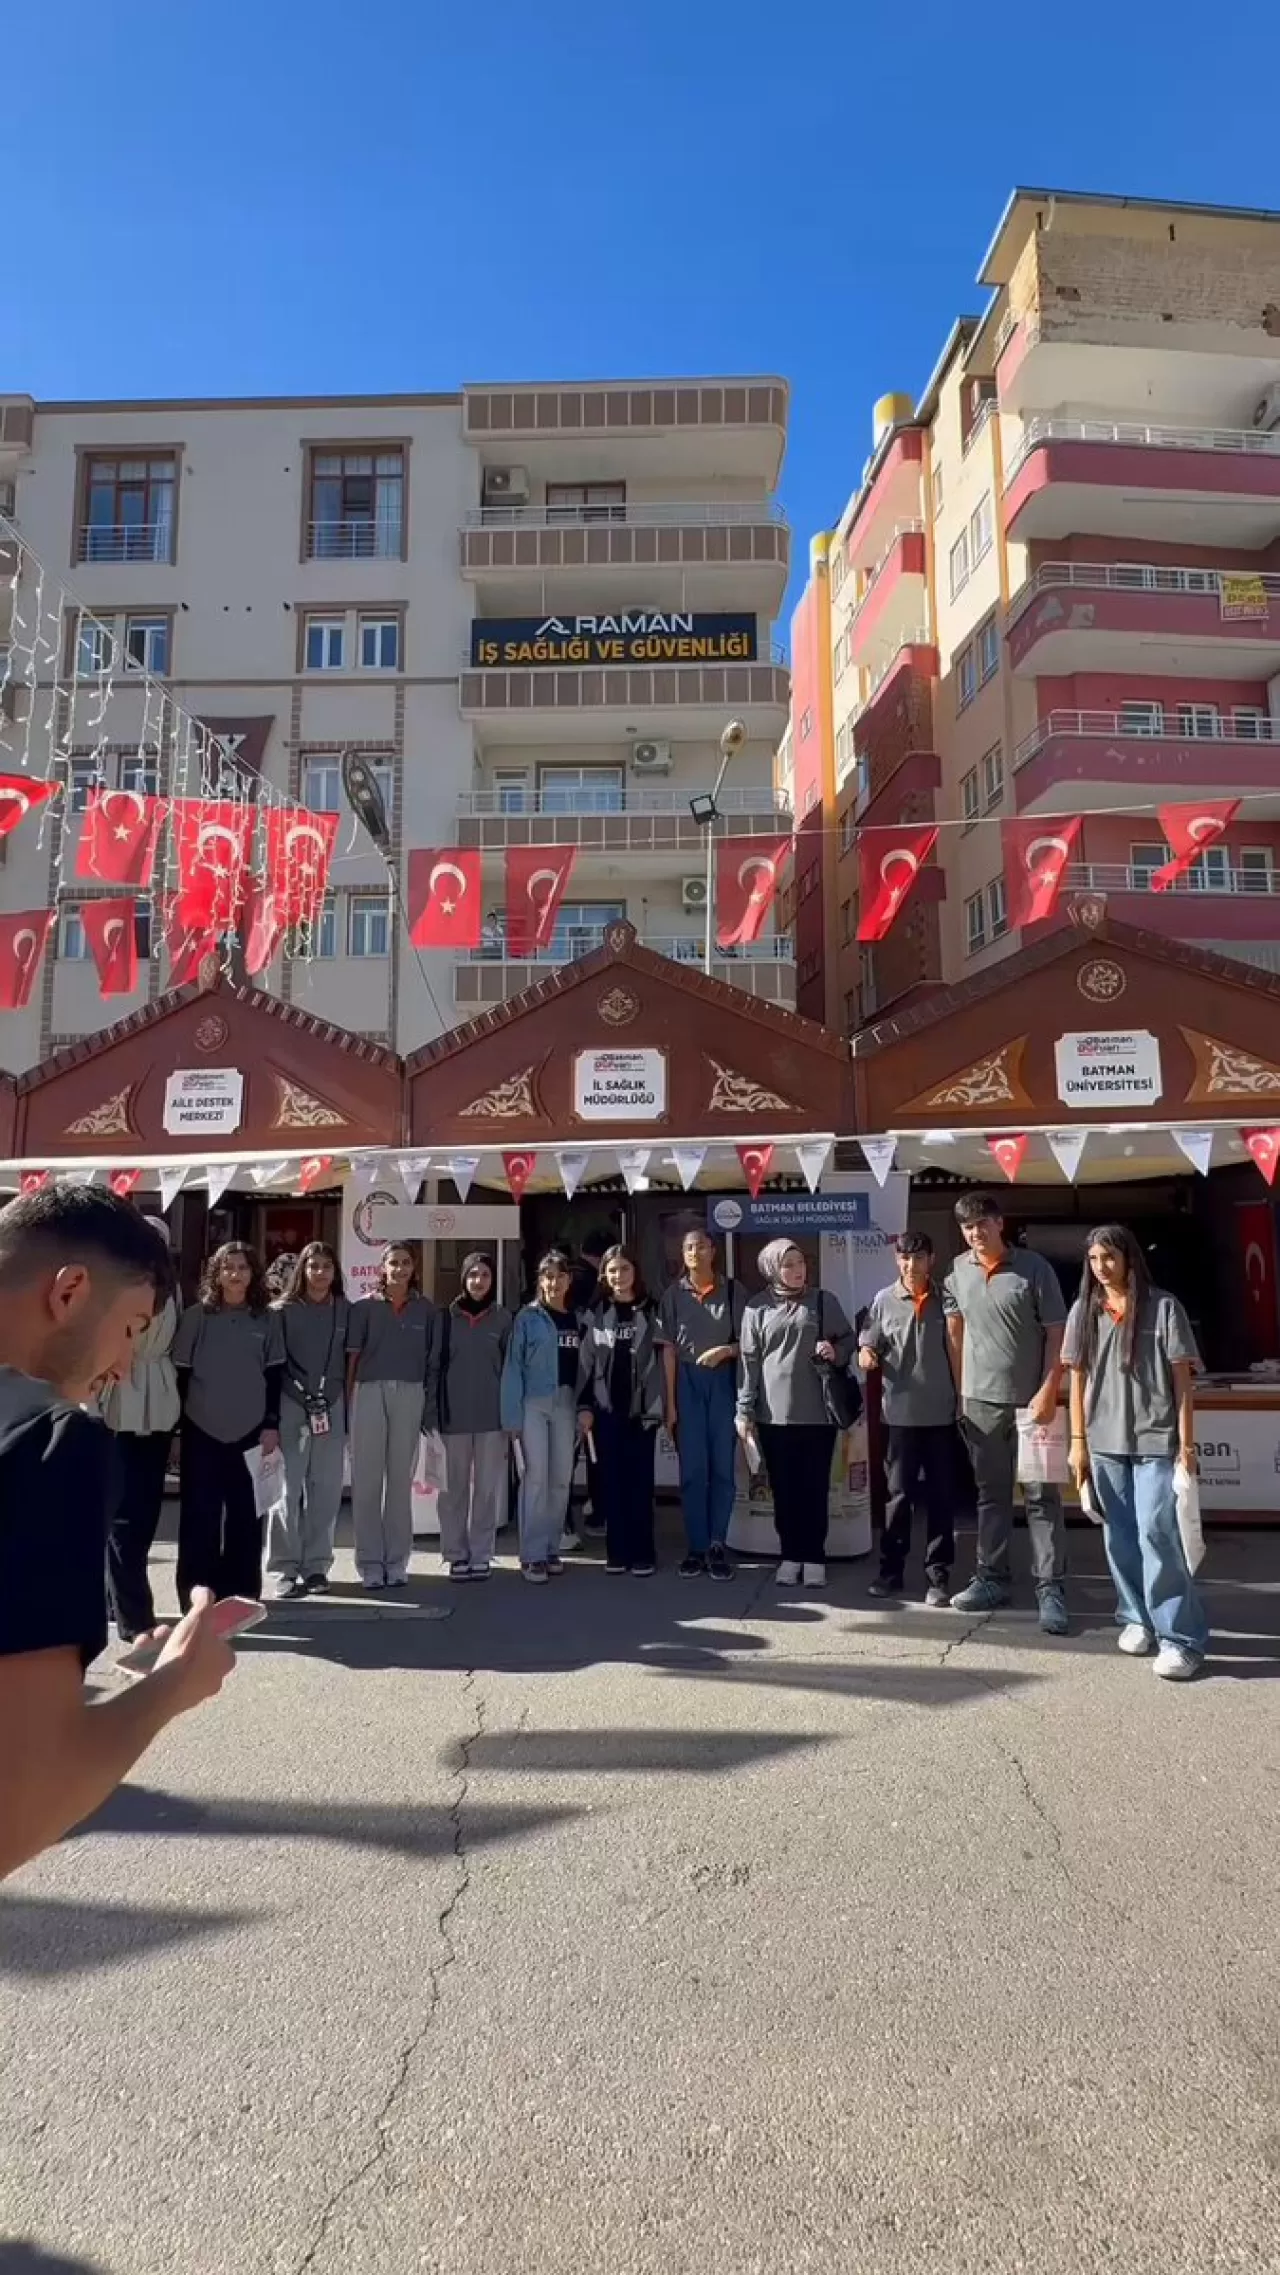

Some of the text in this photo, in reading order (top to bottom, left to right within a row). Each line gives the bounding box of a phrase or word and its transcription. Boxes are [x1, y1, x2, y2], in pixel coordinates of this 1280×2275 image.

[479, 632, 748, 664] İŞ SAĞLIĞI VE GÜVENLİĞİ
[1082, 1064, 1135, 1076] BATMAN
[593, 1079, 646, 1091] İL SAĞLIK
[1066, 1077, 1153, 1092] ÜNİVERSİTESİ
[171, 1097, 234, 1108] AİLE DESTEK
[583, 1092, 655, 1105] MÜDÜRLÜĞÜ
[179, 1110, 224, 1121] MERKEZİ
[750, 1199, 857, 1213] BATMAN BELEDİYESİ
